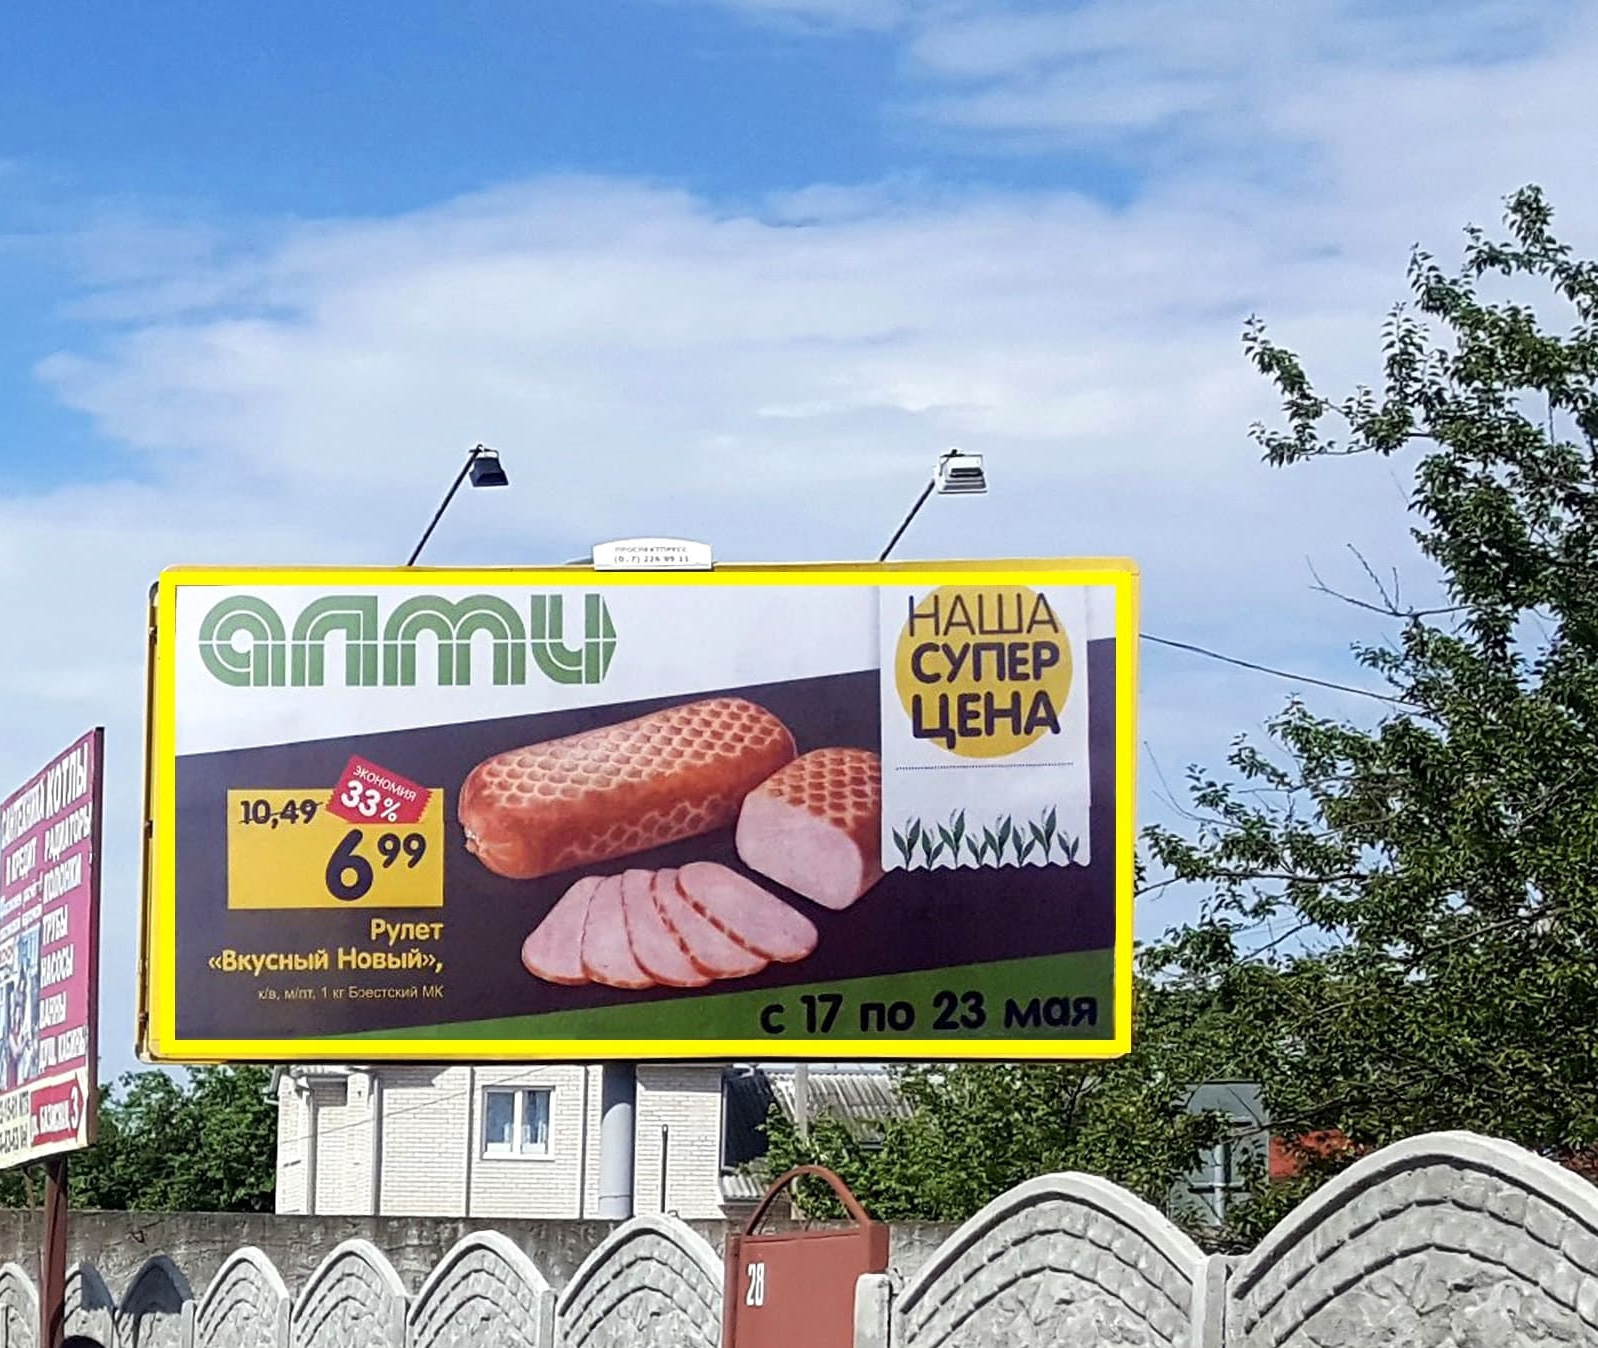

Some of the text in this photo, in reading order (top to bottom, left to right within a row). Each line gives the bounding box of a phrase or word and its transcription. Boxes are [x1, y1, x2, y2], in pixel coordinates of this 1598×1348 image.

[908, 592, 1059, 637] НАША
[911, 641, 1060, 684] СУПЕР
[912, 690, 1061, 750] ЦЕНА
[46, 742, 88, 819] КОТЛЫ
[341, 779, 402, 823] 33%
[353, 764, 417, 802] ЭКОНОМИЯ
[44, 802, 92, 862] РАДИАТОРЫ
[240, 798, 321, 829] 10,49
[43, 904, 68, 946] ТРУБЫ
[370, 918, 444, 946] Рулет
[41, 944, 74, 989] НАСОСЫ
[208, 947, 444, 976] «Вкусный Новый»,
[321, 986, 328, 999] 1
[332, 988, 344, 999] кг
[422, 985, 444, 998] МК
[760, 990, 1098, 1034] с 17 по 23 мая
[746, 1262, 765, 1306] 28
